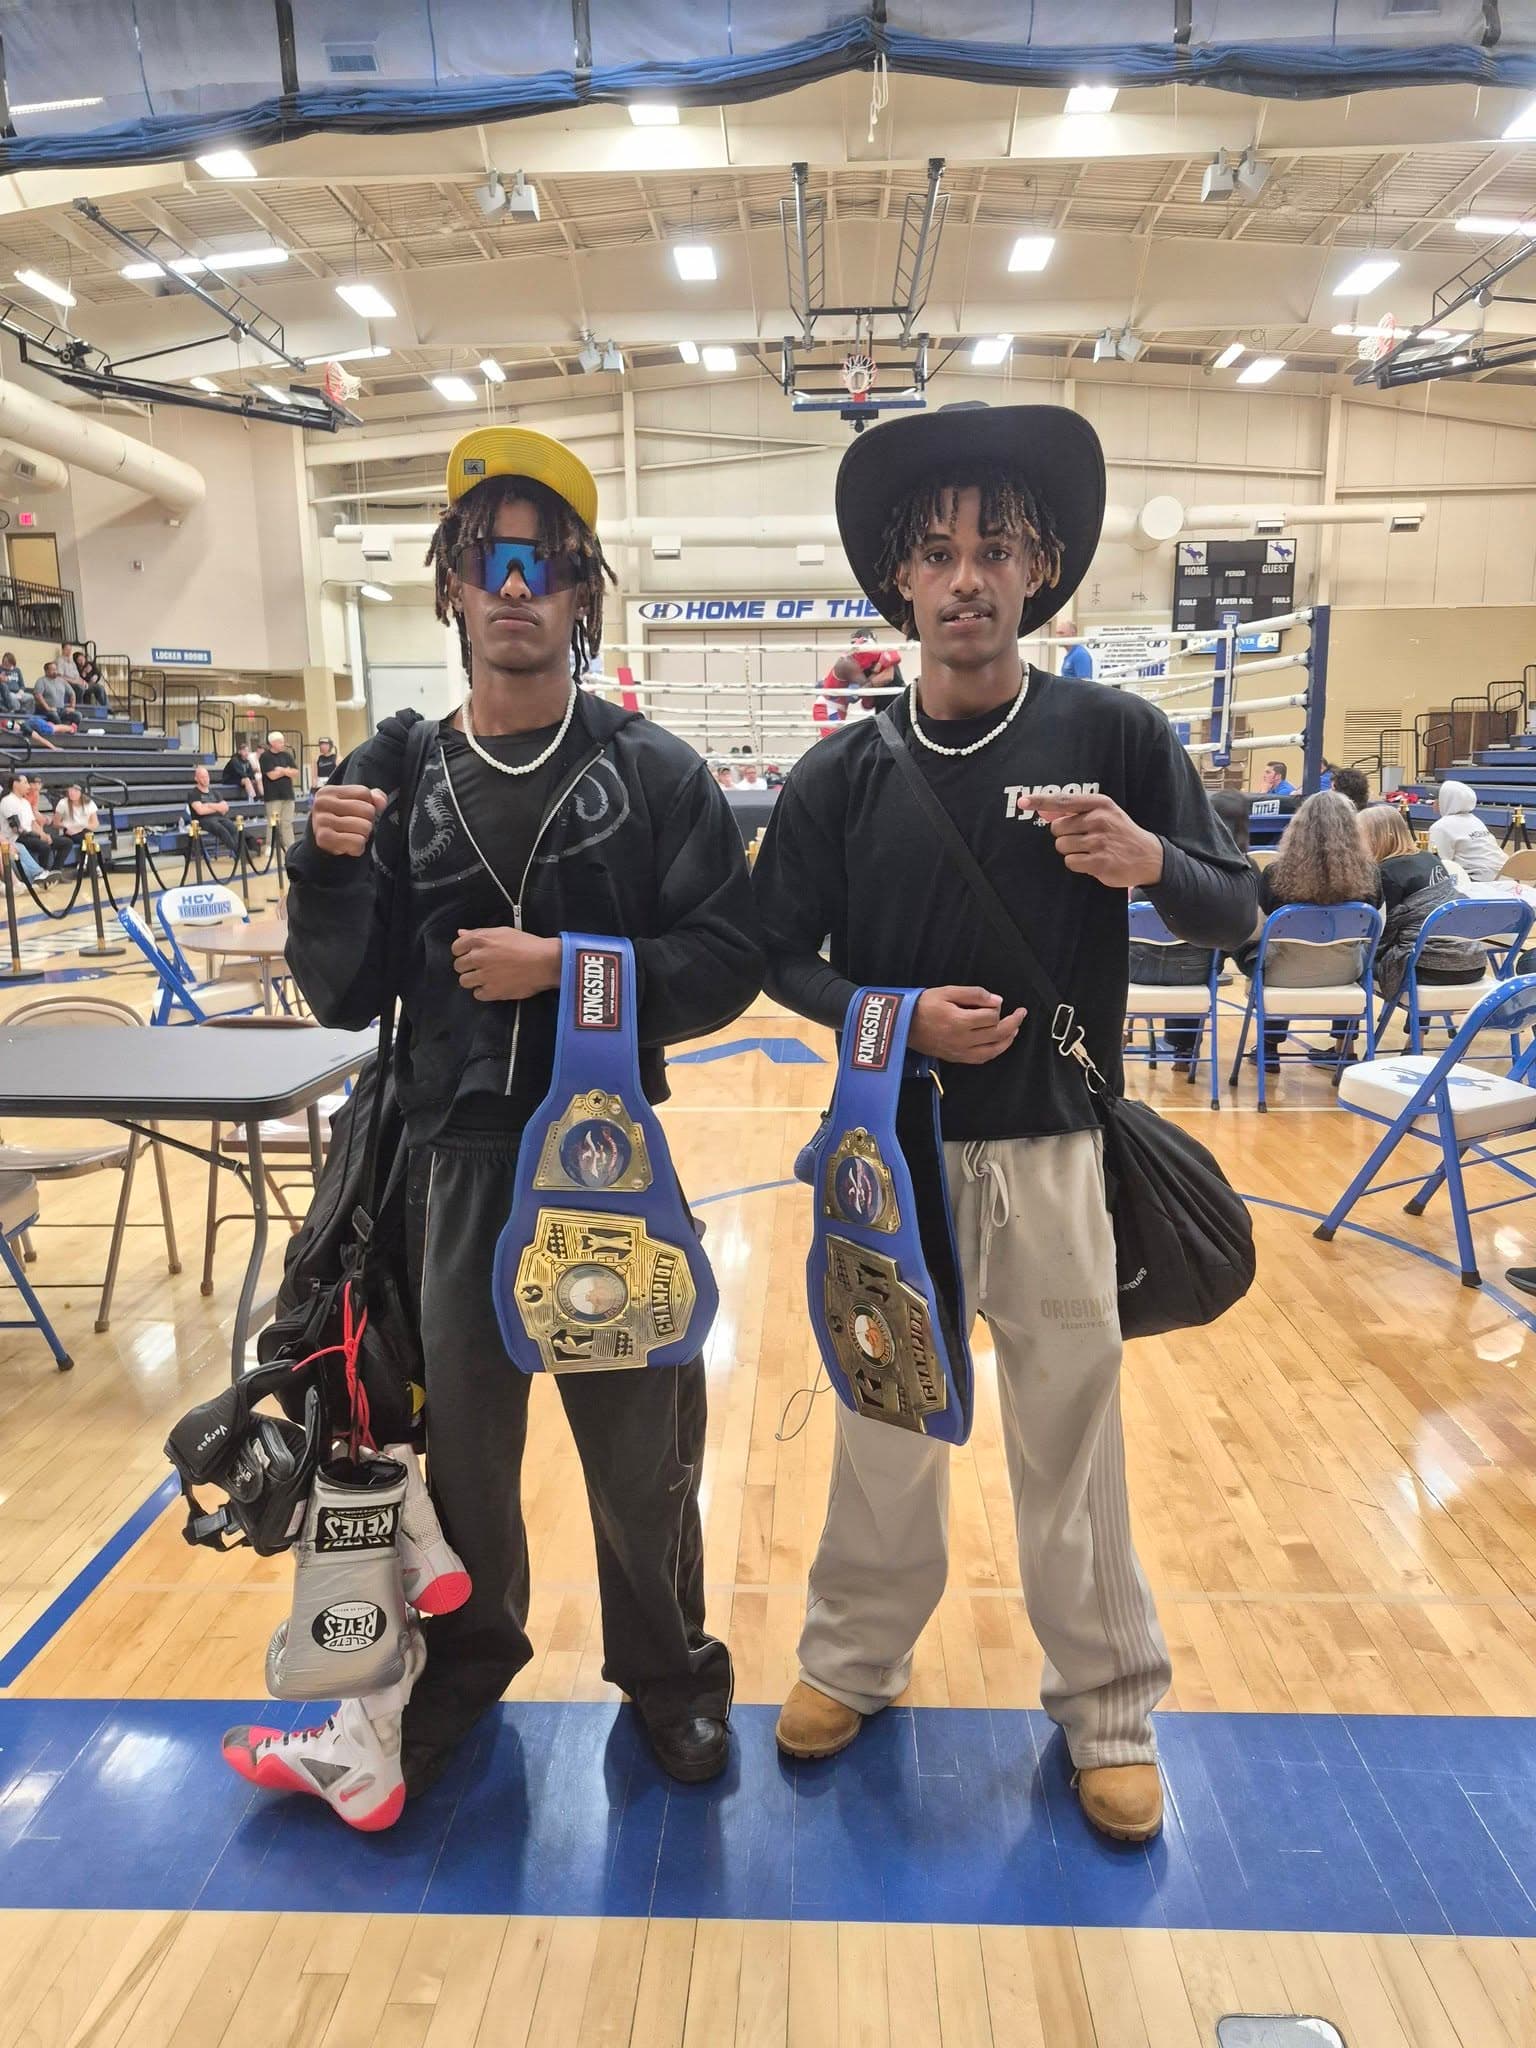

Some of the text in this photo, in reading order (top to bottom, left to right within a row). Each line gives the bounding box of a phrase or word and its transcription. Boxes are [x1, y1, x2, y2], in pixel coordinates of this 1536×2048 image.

[1184, 566, 1208, 576] HOME
[1262, 564, 1289, 574] GUEST
[685, 599, 881, 620] HOME OF THE
[182, 894, 214, 905] HCV
[583, 955, 604, 1024] RINGSIDE
[857, 996, 886, 1064] RINGSIDE
[652, 1257, 674, 1333] CHAMPION
[911, 1307, 936, 1397] CHAMPION
[197, 1424, 228, 1451] Vargas
[325, 1507, 393, 1540] REYES
[323, 1607, 378, 1640] REYES
[329, 1637, 368, 1647] CLETO
